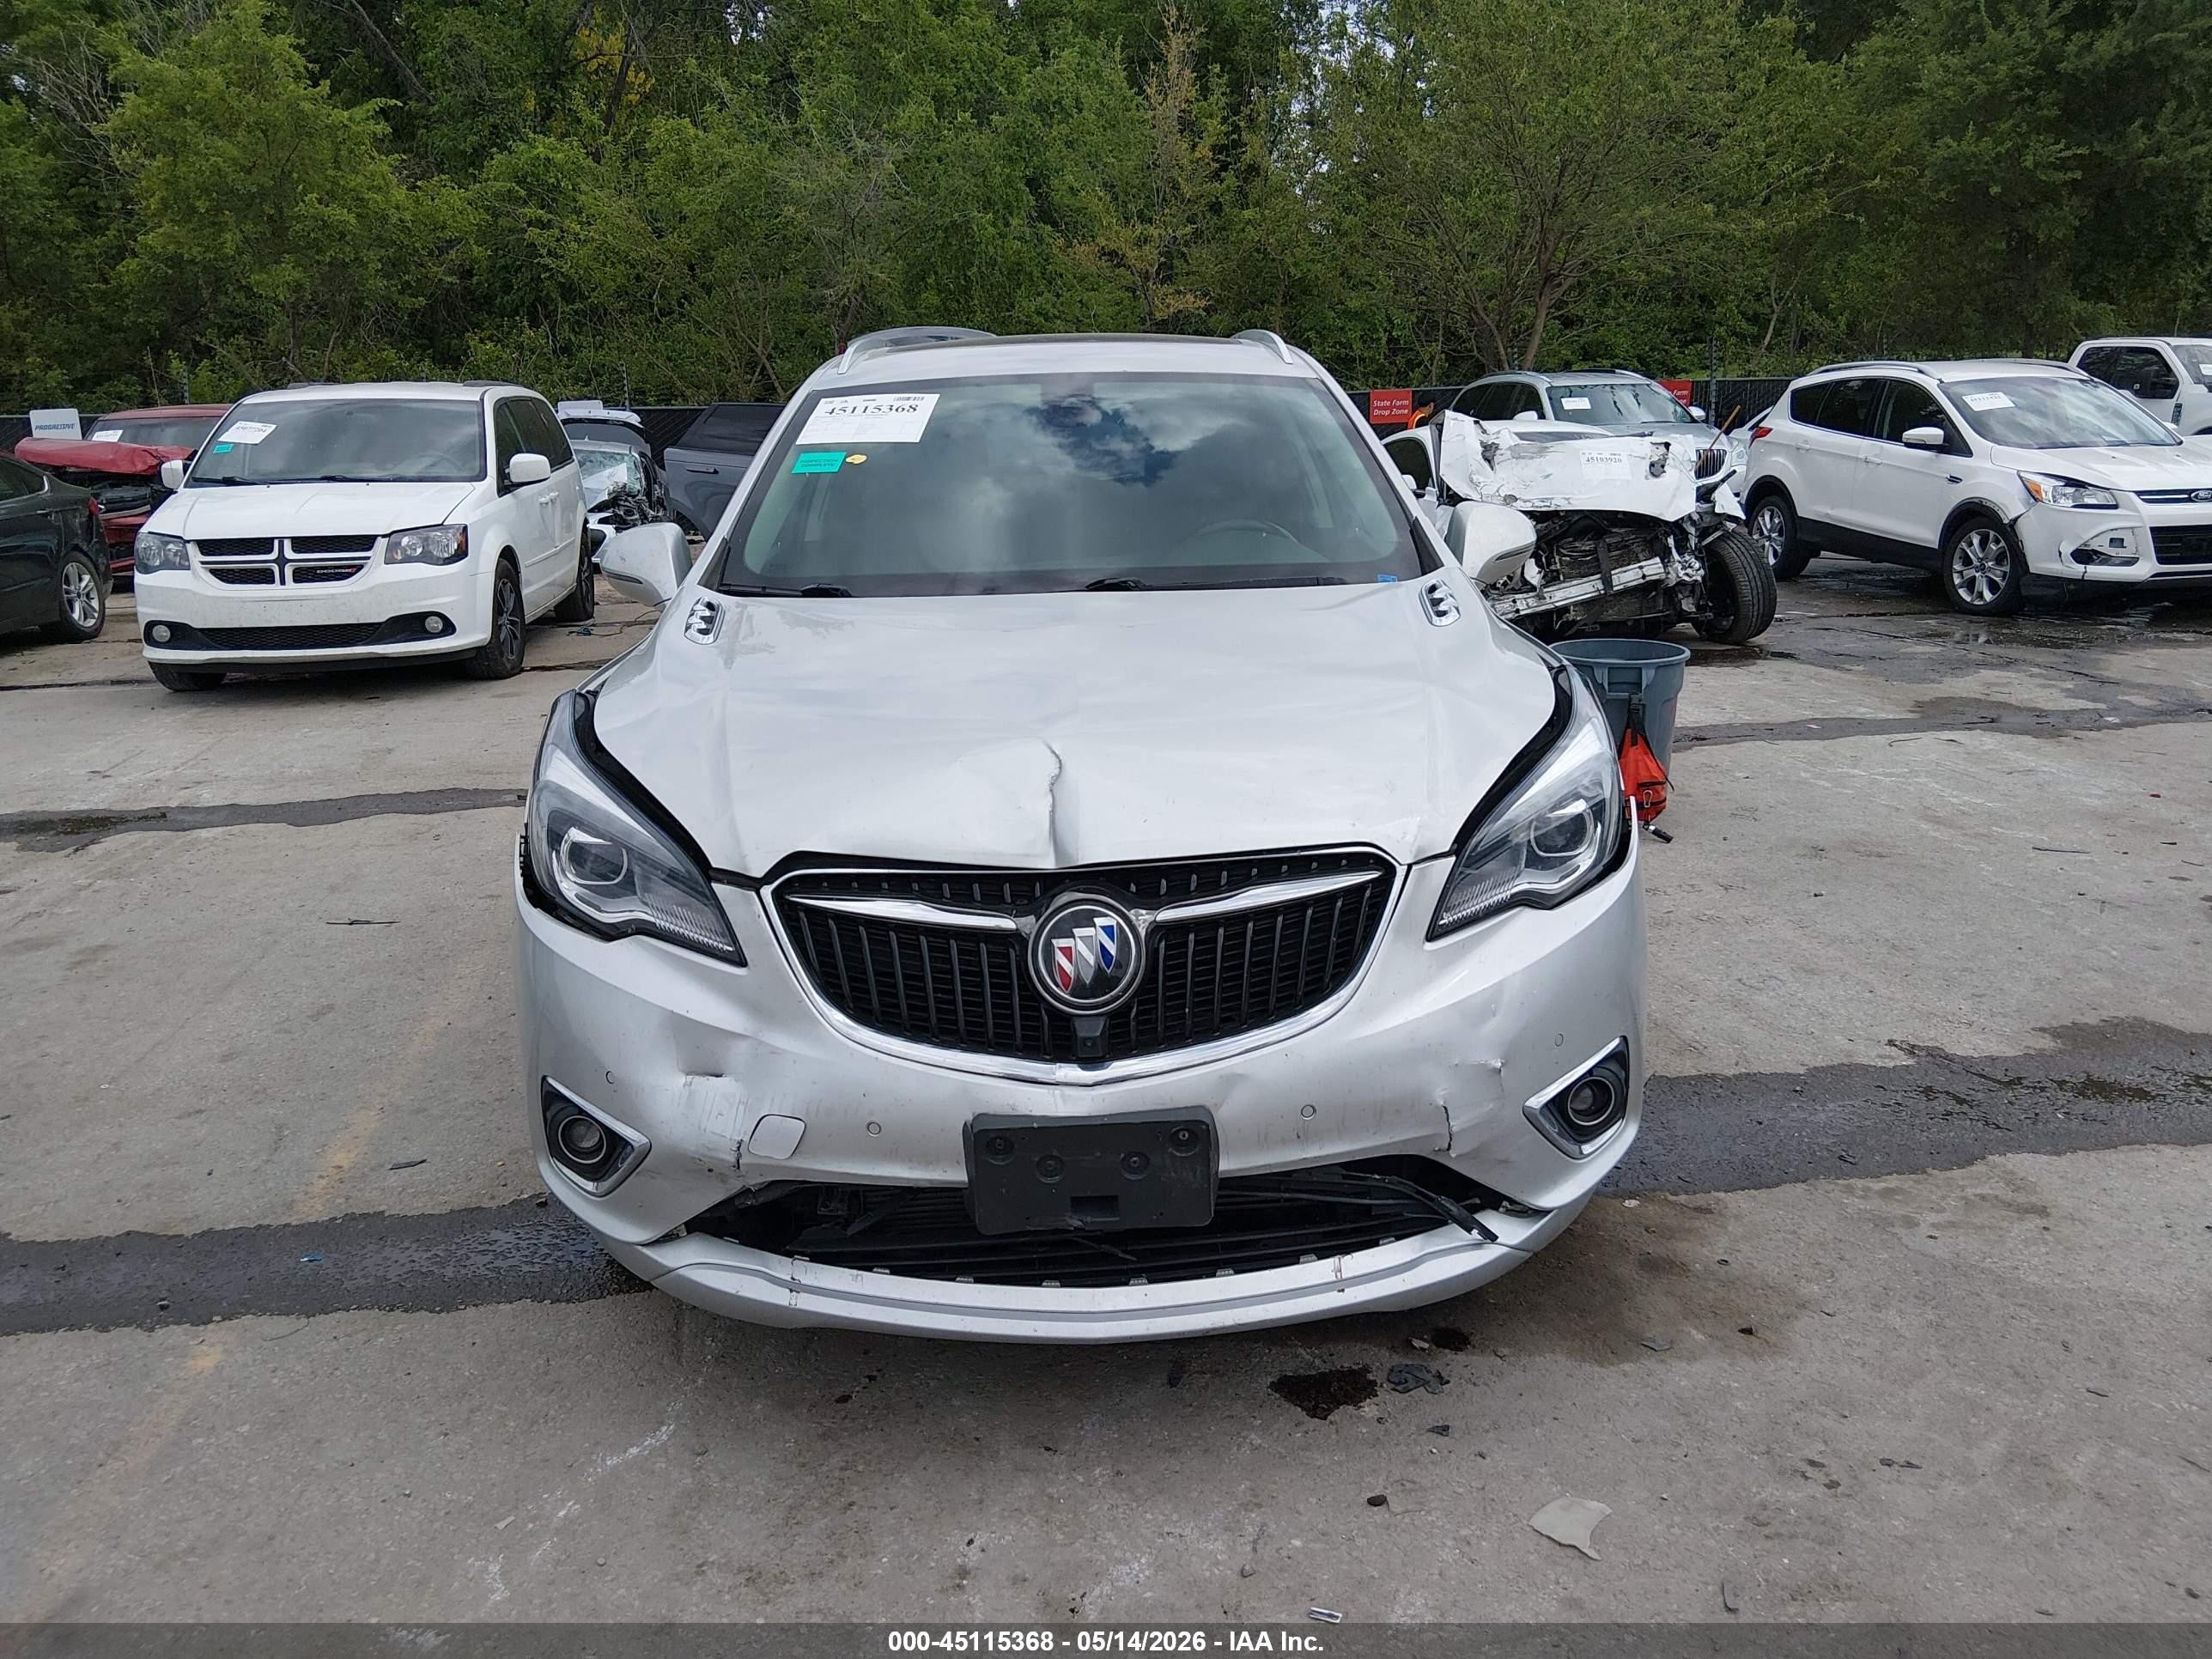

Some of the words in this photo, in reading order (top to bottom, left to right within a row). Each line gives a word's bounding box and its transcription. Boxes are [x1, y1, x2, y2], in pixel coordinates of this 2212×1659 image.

[1392, 398, 1409, 407] Farm
[823, 404, 919, 416] 45115368
[1373, 409, 1390, 417] Drop
[34, 422, 76, 431] PROGRESSIVE
